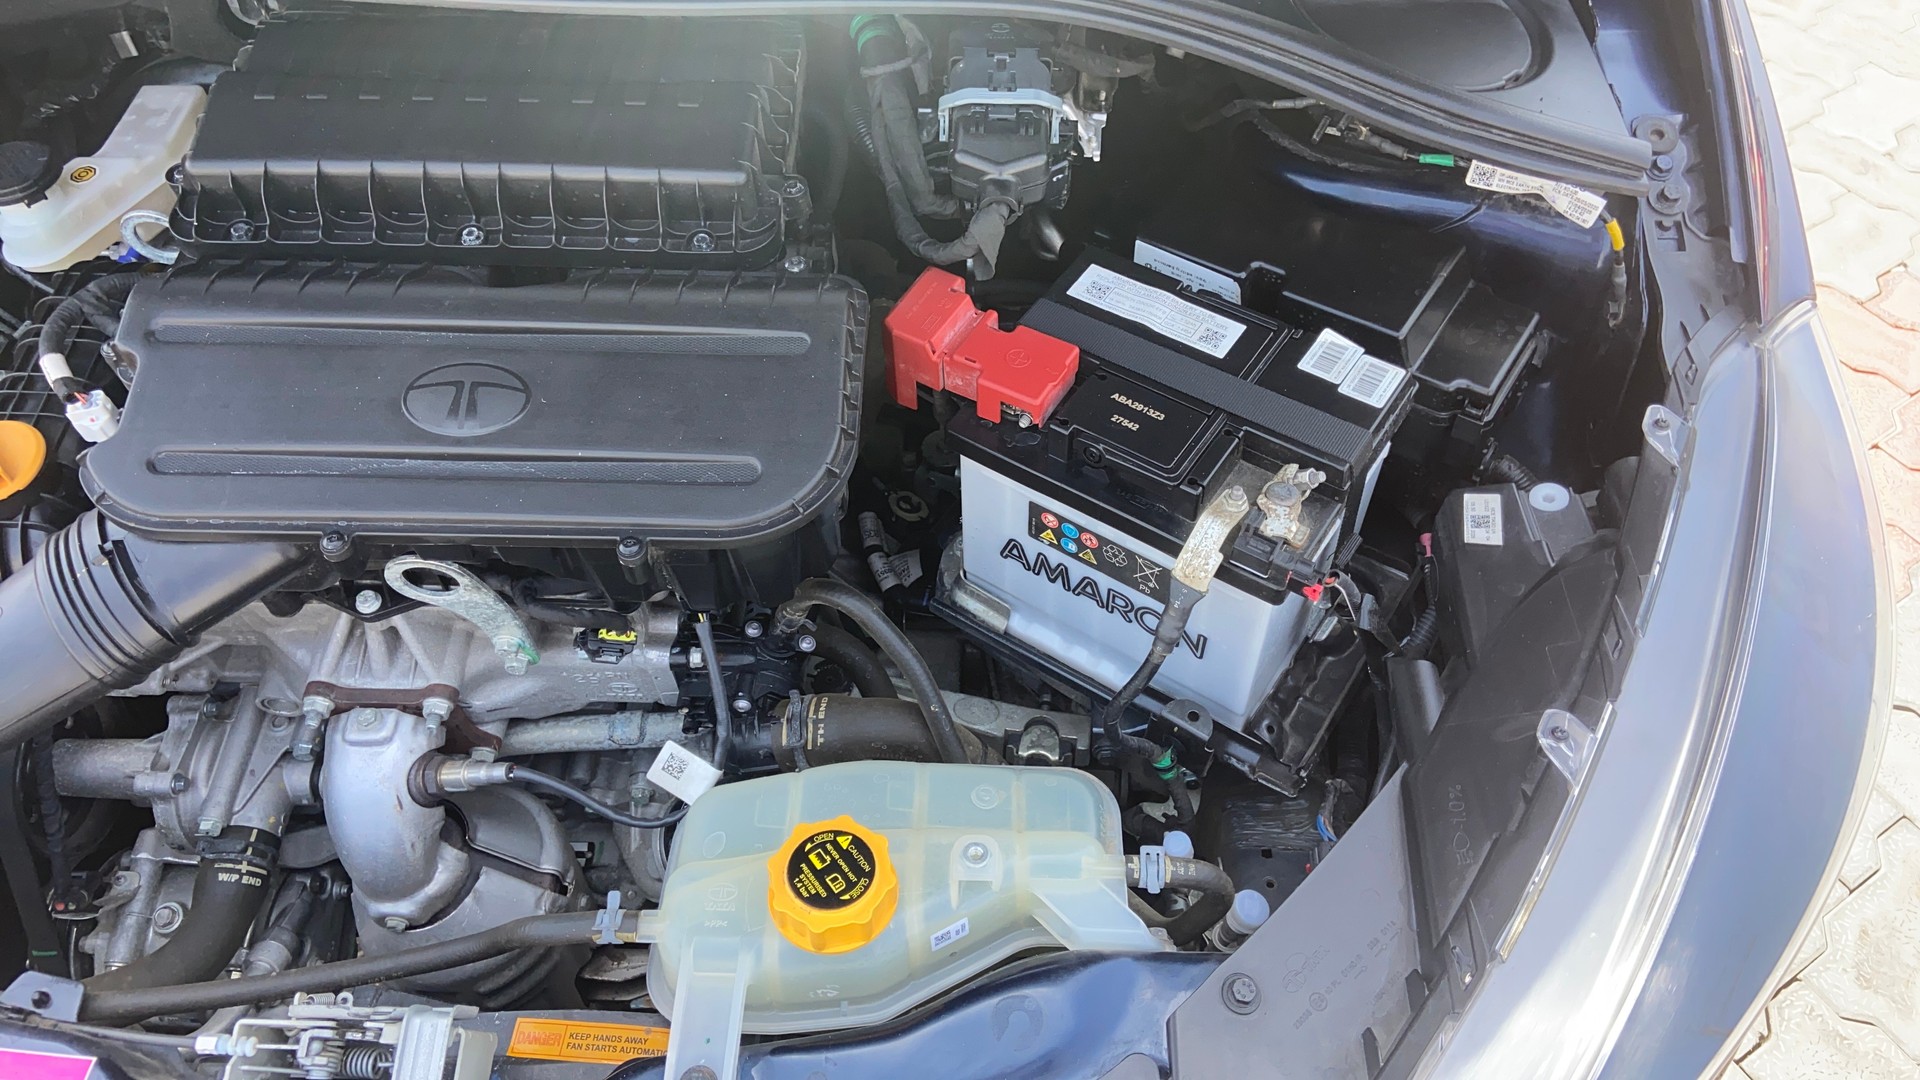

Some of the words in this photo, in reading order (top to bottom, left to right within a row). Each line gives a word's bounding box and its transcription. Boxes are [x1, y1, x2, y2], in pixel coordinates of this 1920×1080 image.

[1110, 393, 1166, 420] ABA2913Z3
[1110, 414, 1140, 431] 27542
[1000, 538, 1208, 660] AMARON
[1139, 584, 1151, 594] Pb
[817, 696, 829, 720] END
[817, 722, 826, 748] TH
[814, 833, 834, 842] OPEN
[825, 843, 839, 860] NEVER
[837, 859, 849, 873] OPEN
[846, 871, 858, 883] HOT
[848, 844, 871, 872] CAUTION
[218, 872, 240, 883] W/P
[242, 876, 262, 887] END
[793, 878, 801, 889] 1.4
[799, 886, 810, 898] bar
[799, 863, 827, 898] PRESSURISED
[799, 874, 817, 894] SYSTEM
[850, 877, 869, 900] CLOSE
[517, 1030, 562, 1047] DANGER
[566, 1042, 583, 1050] FAN
[585, 1044, 617, 1053] STARTS
[569, 1032, 592, 1040] KEEP
[593, 1034, 623, 1043] HANDS
[624, 1036, 649, 1045] AWAY
